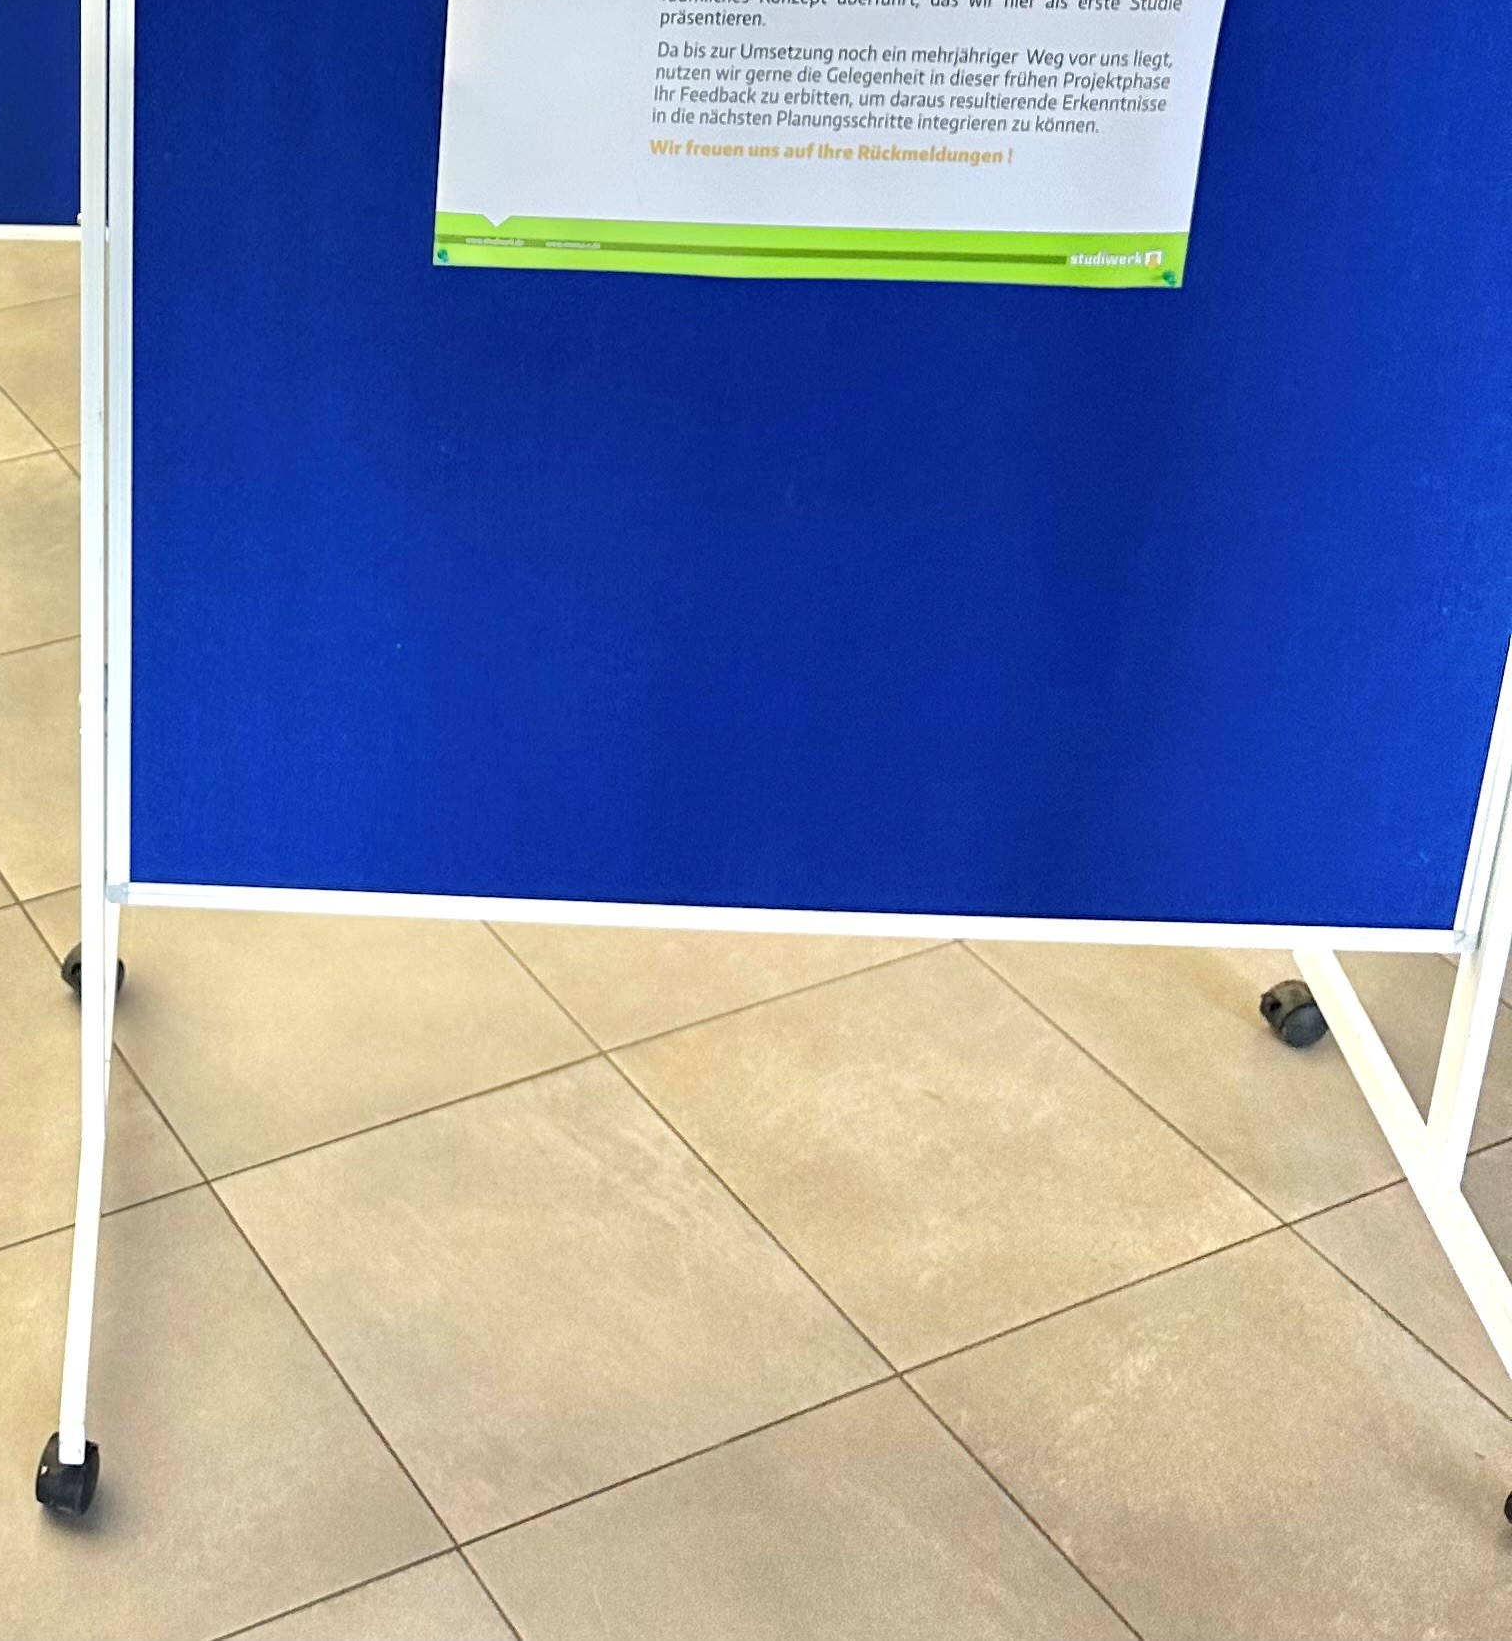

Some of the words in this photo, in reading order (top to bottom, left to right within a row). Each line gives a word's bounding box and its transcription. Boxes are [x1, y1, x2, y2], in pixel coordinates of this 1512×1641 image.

[659, 8, 766, 29] präsentieren.
[657, 40, 679, 59] Da
[683, 40, 707, 60] bis
[709, 45, 737, 60] zur
[740, 42, 834, 65] Umsetzung
[837, 43, 878, 63] noch
[881, 44, 907, 63] ein
[911, 45, 1020, 68] mehrjähriger
[1026, 48, 1065, 70] Weg
[1068, 52, 1098, 67] vor
[1099, 53, 1129, 68] uns
[1133, 48, 1173, 71] liegt,
[655, 64, 711, 82] nutzen
[715, 64, 742, 82] wir
[745, 68, 794, 87] gerne
[796, 65, 823, 84] die
[826, 66, 926, 89] Gelegenheit
[929, 68, 945, 87] in
[949, 68, 1001, 88] dieser
[1004, 68, 1059, 89] frühen
[1062, 70, 1171, 94] Projektphase
[653, 84, 677, 103] Ihr
[679, 85, 757, 105] Feedback
[760, 90, 781, 105] zu
[783, 87, 854, 109] erbitten,
[858, 93, 886, 108] um
[889, 88, 946, 109] daraus
[949, 90, 1059, 112] resultierende
[1062, 93, 1168, 113] Erkenntnisse
[651, 106, 667, 124] in
[670, 106, 696, 125] die
[698, 107, 773, 127] nächsten
[776, 108, 914, 132] Planungsschritte
[917, 112, 1008, 135] integrieren
[1011, 118, 1031, 133] zu
[1034, 114, 1099, 135] können.
[649, 138, 684, 156] Wir
[684, 138, 747, 158] freuen
[745, 144, 781, 159] uns
[782, 141, 817, 160] auf
[816, 142, 855, 161] Ihre
[856, 143, 1005, 168] Rückmeldungen
[1070, 251, 1142, 267] studiwerk
